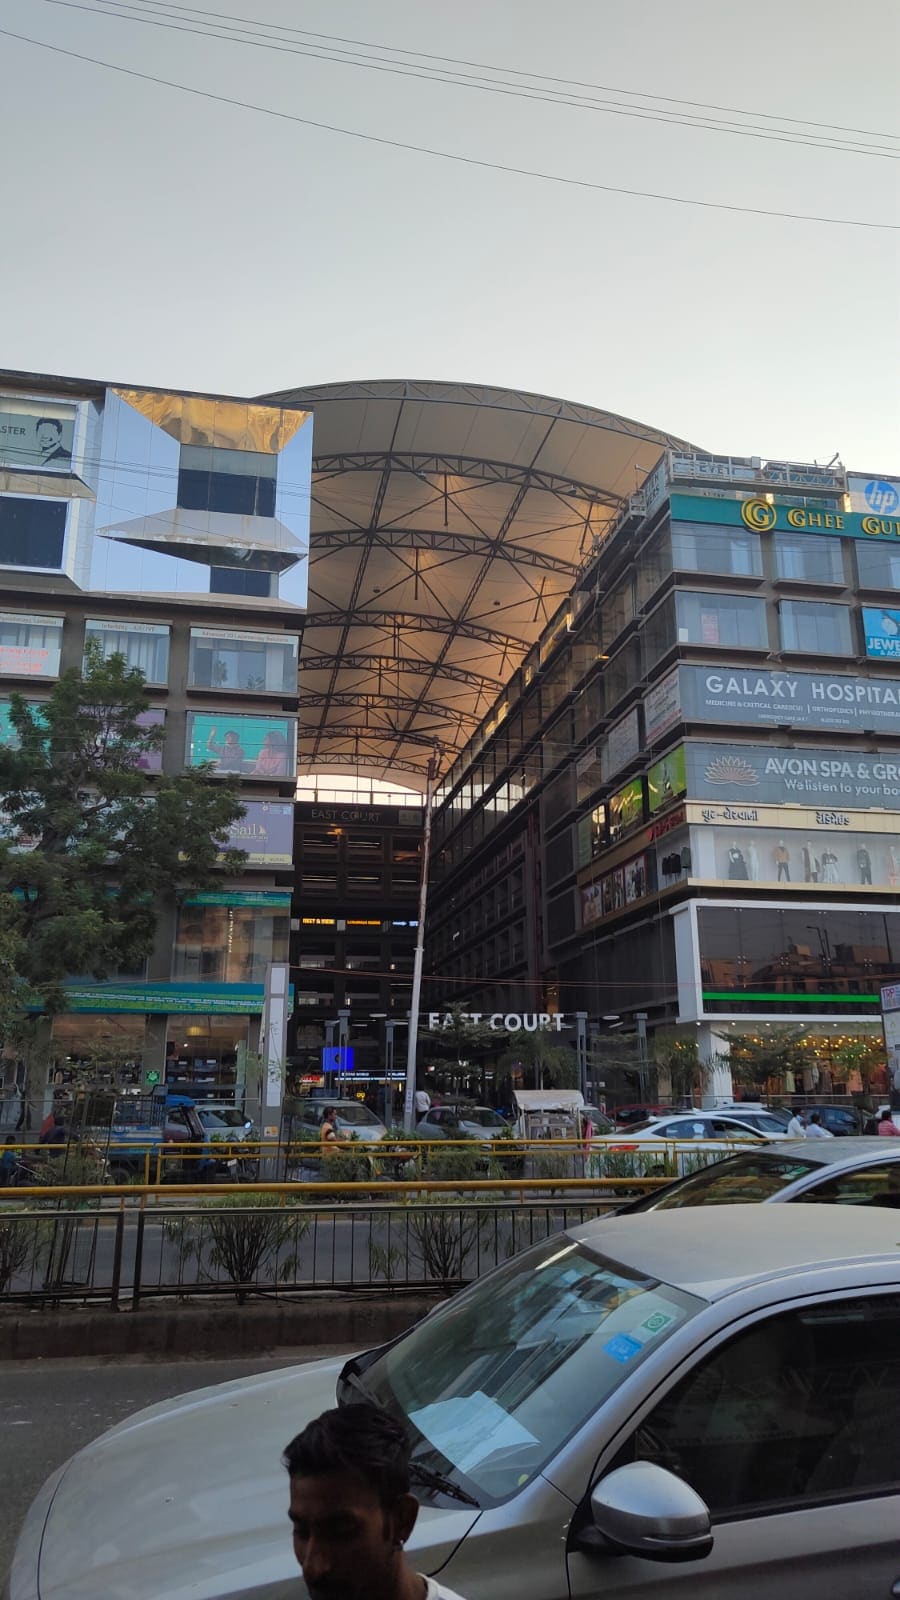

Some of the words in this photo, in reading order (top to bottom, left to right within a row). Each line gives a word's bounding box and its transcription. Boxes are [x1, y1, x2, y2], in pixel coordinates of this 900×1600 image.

[0, 425, 26, 436] STER
[705, 675, 798, 698] GALAXY
[764, 757, 818, 776] AVON
[820, 760, 855, 778] SPA
[856, 762, 871, 780] &
[784, 778, 804, 791] We
[805, 778, 838, 792] listen
[855, 785, 880, 796] your
[311, 809, 337, 820] EAST
[341, 810, 382, 823] COURT
[489, 1012, 565, 1032] COURT
